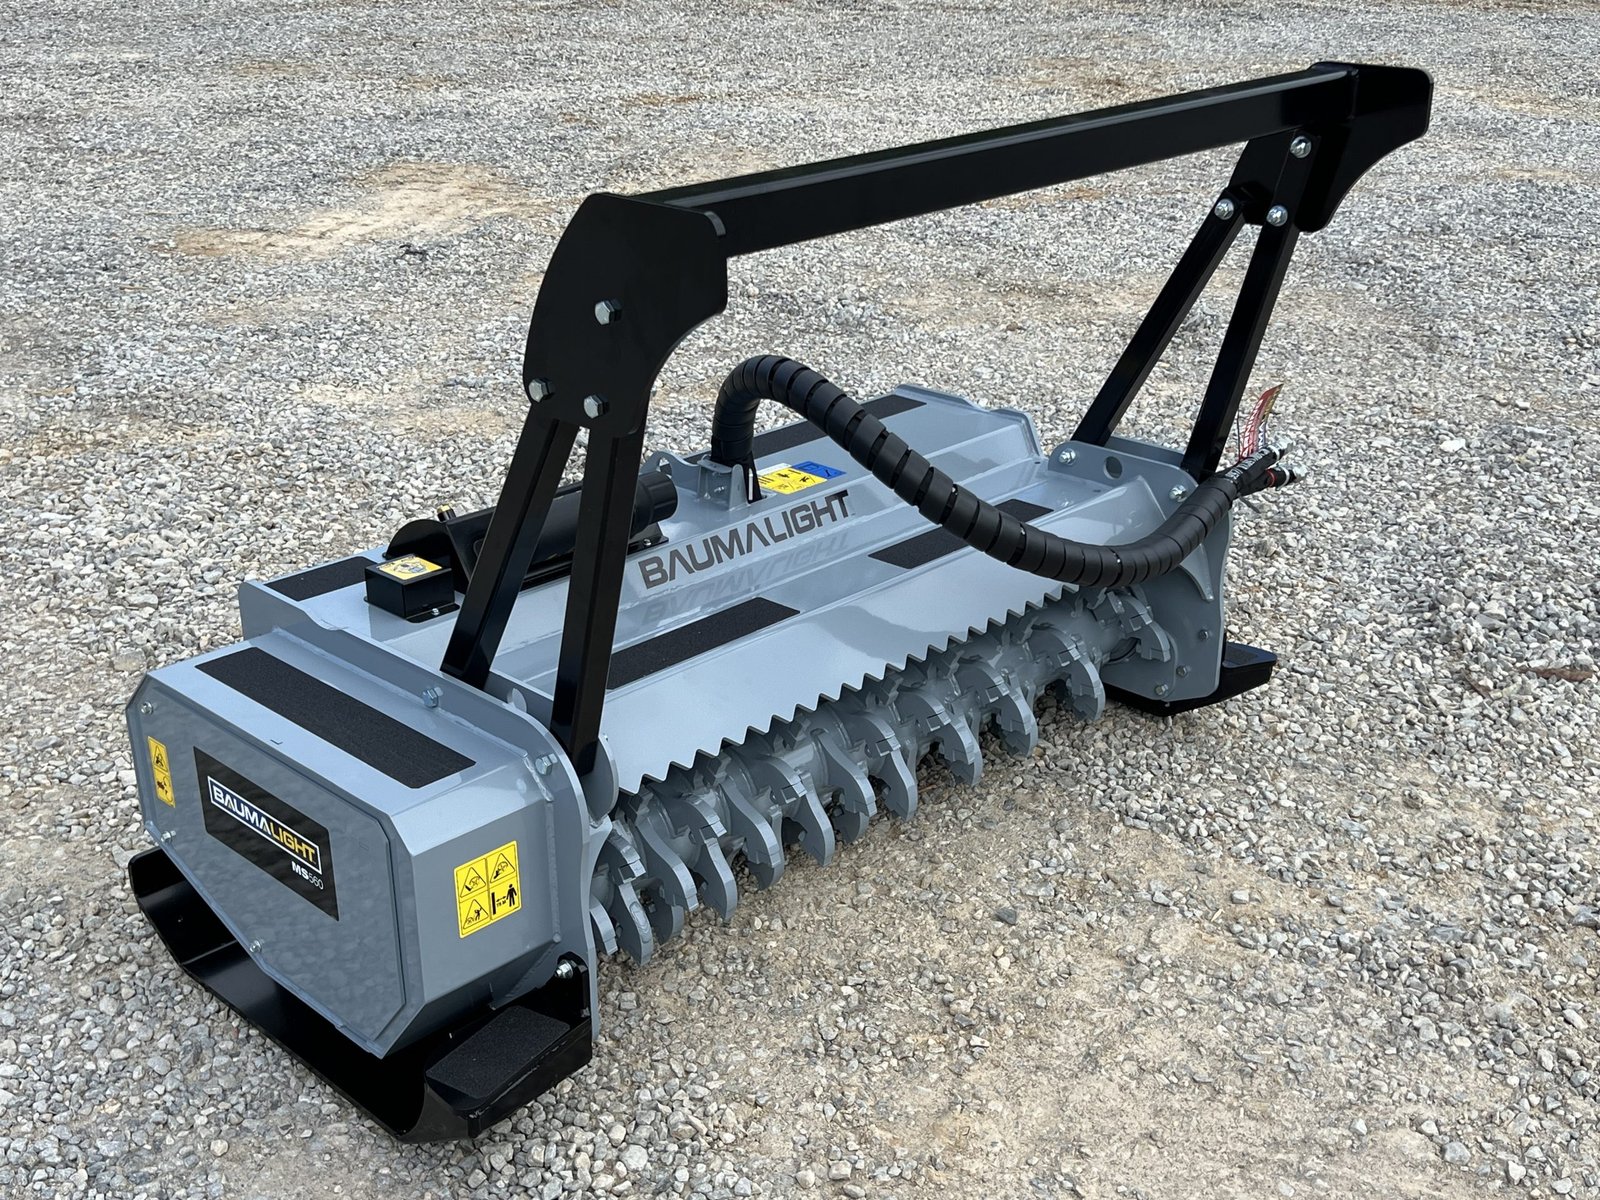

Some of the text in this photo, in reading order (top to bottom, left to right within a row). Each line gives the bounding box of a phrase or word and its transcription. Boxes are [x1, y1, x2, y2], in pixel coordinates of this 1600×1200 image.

[638, 489, 849, 590] BAUMALIGHT
[212, 785, 316, 863] BAUMALIGHT
[291, 861, 324, 890] MS560
